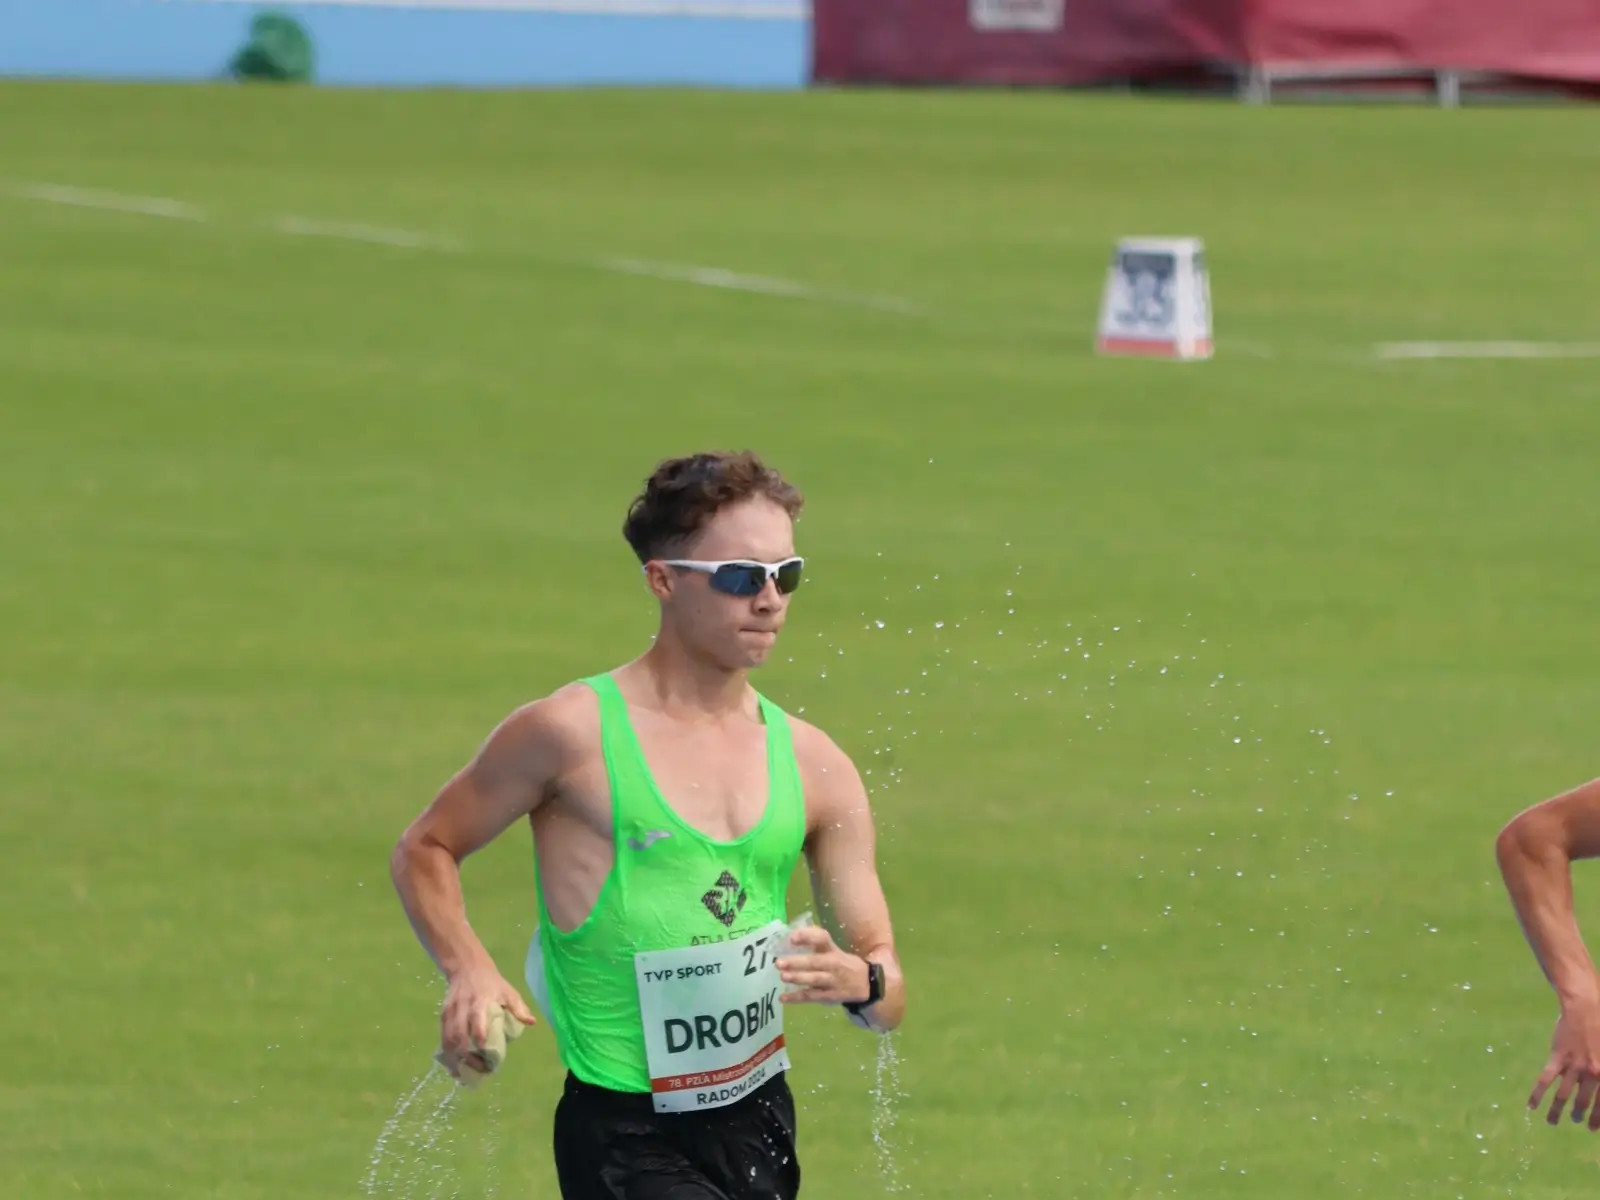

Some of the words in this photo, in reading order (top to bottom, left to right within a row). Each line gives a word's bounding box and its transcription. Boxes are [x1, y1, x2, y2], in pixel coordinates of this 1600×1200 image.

[742, 933, 778, 977] 27
[644, 969, 674, 983] TVP
[677, 963, 722, 979] SPORT
[664, 987, 777, 1054] DROBIK
[697, 1080, 747, 1105] RADOM
